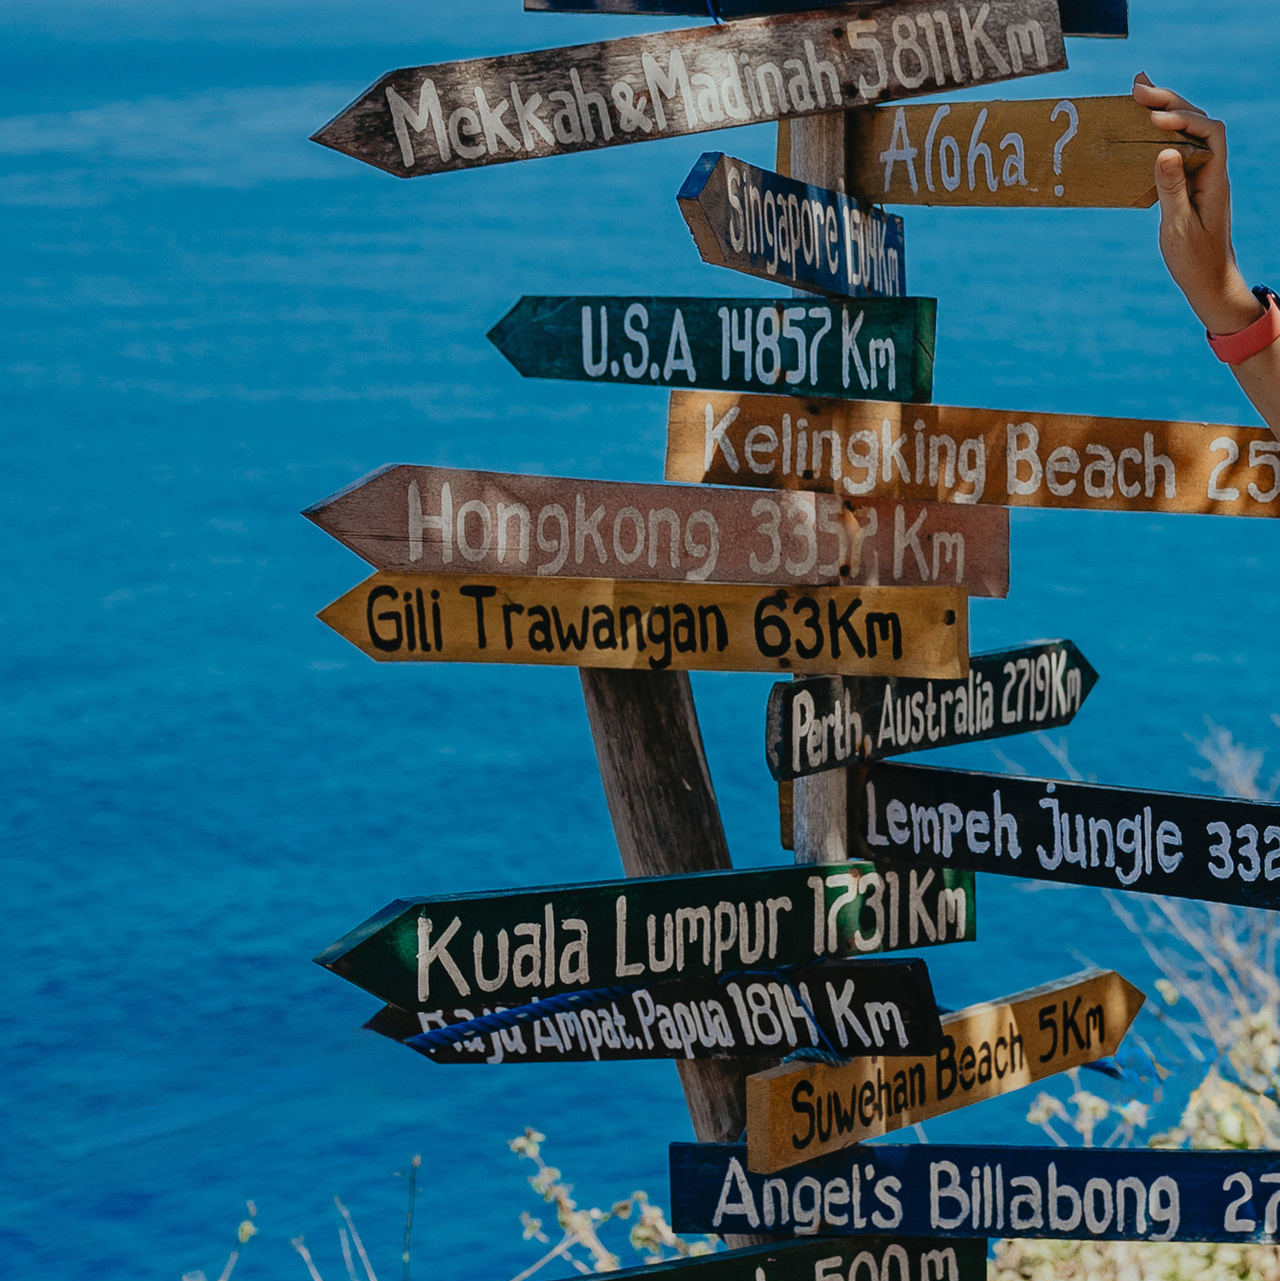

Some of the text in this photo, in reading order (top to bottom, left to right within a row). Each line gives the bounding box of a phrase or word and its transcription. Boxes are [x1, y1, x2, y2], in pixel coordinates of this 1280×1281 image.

[879, 100, 1080, 198] Aloha ?
[727, 166, 839, 282] Singapore
[581, 303, 896, 391] U.S.A 14857 Km
[704, 403, 987, 505] Kelingking
[1006, 422, 1177, 498] Beach
[407, 478, 721, 581] Hongkong
[893, 503, 965, 584] Km
[366, 585, 442, 653] Gili
[460, 585, 729, 670] Trawangan
[877, 670, 994, 748] Australia
[865, 780, 1022, 861] Lempeh
[415, 902, 590, 1003] Kuala
[615, 895, 793, 978] Lumpur
[829, 977, 908, 1050] Km
[792, 1057, 927, 1151] Suwehan
[937, 1031, 1024, 1102] Beach
[712, 1156, 901, 1239] Angel's
[929, 1160, 1180, 1242] Billabong
